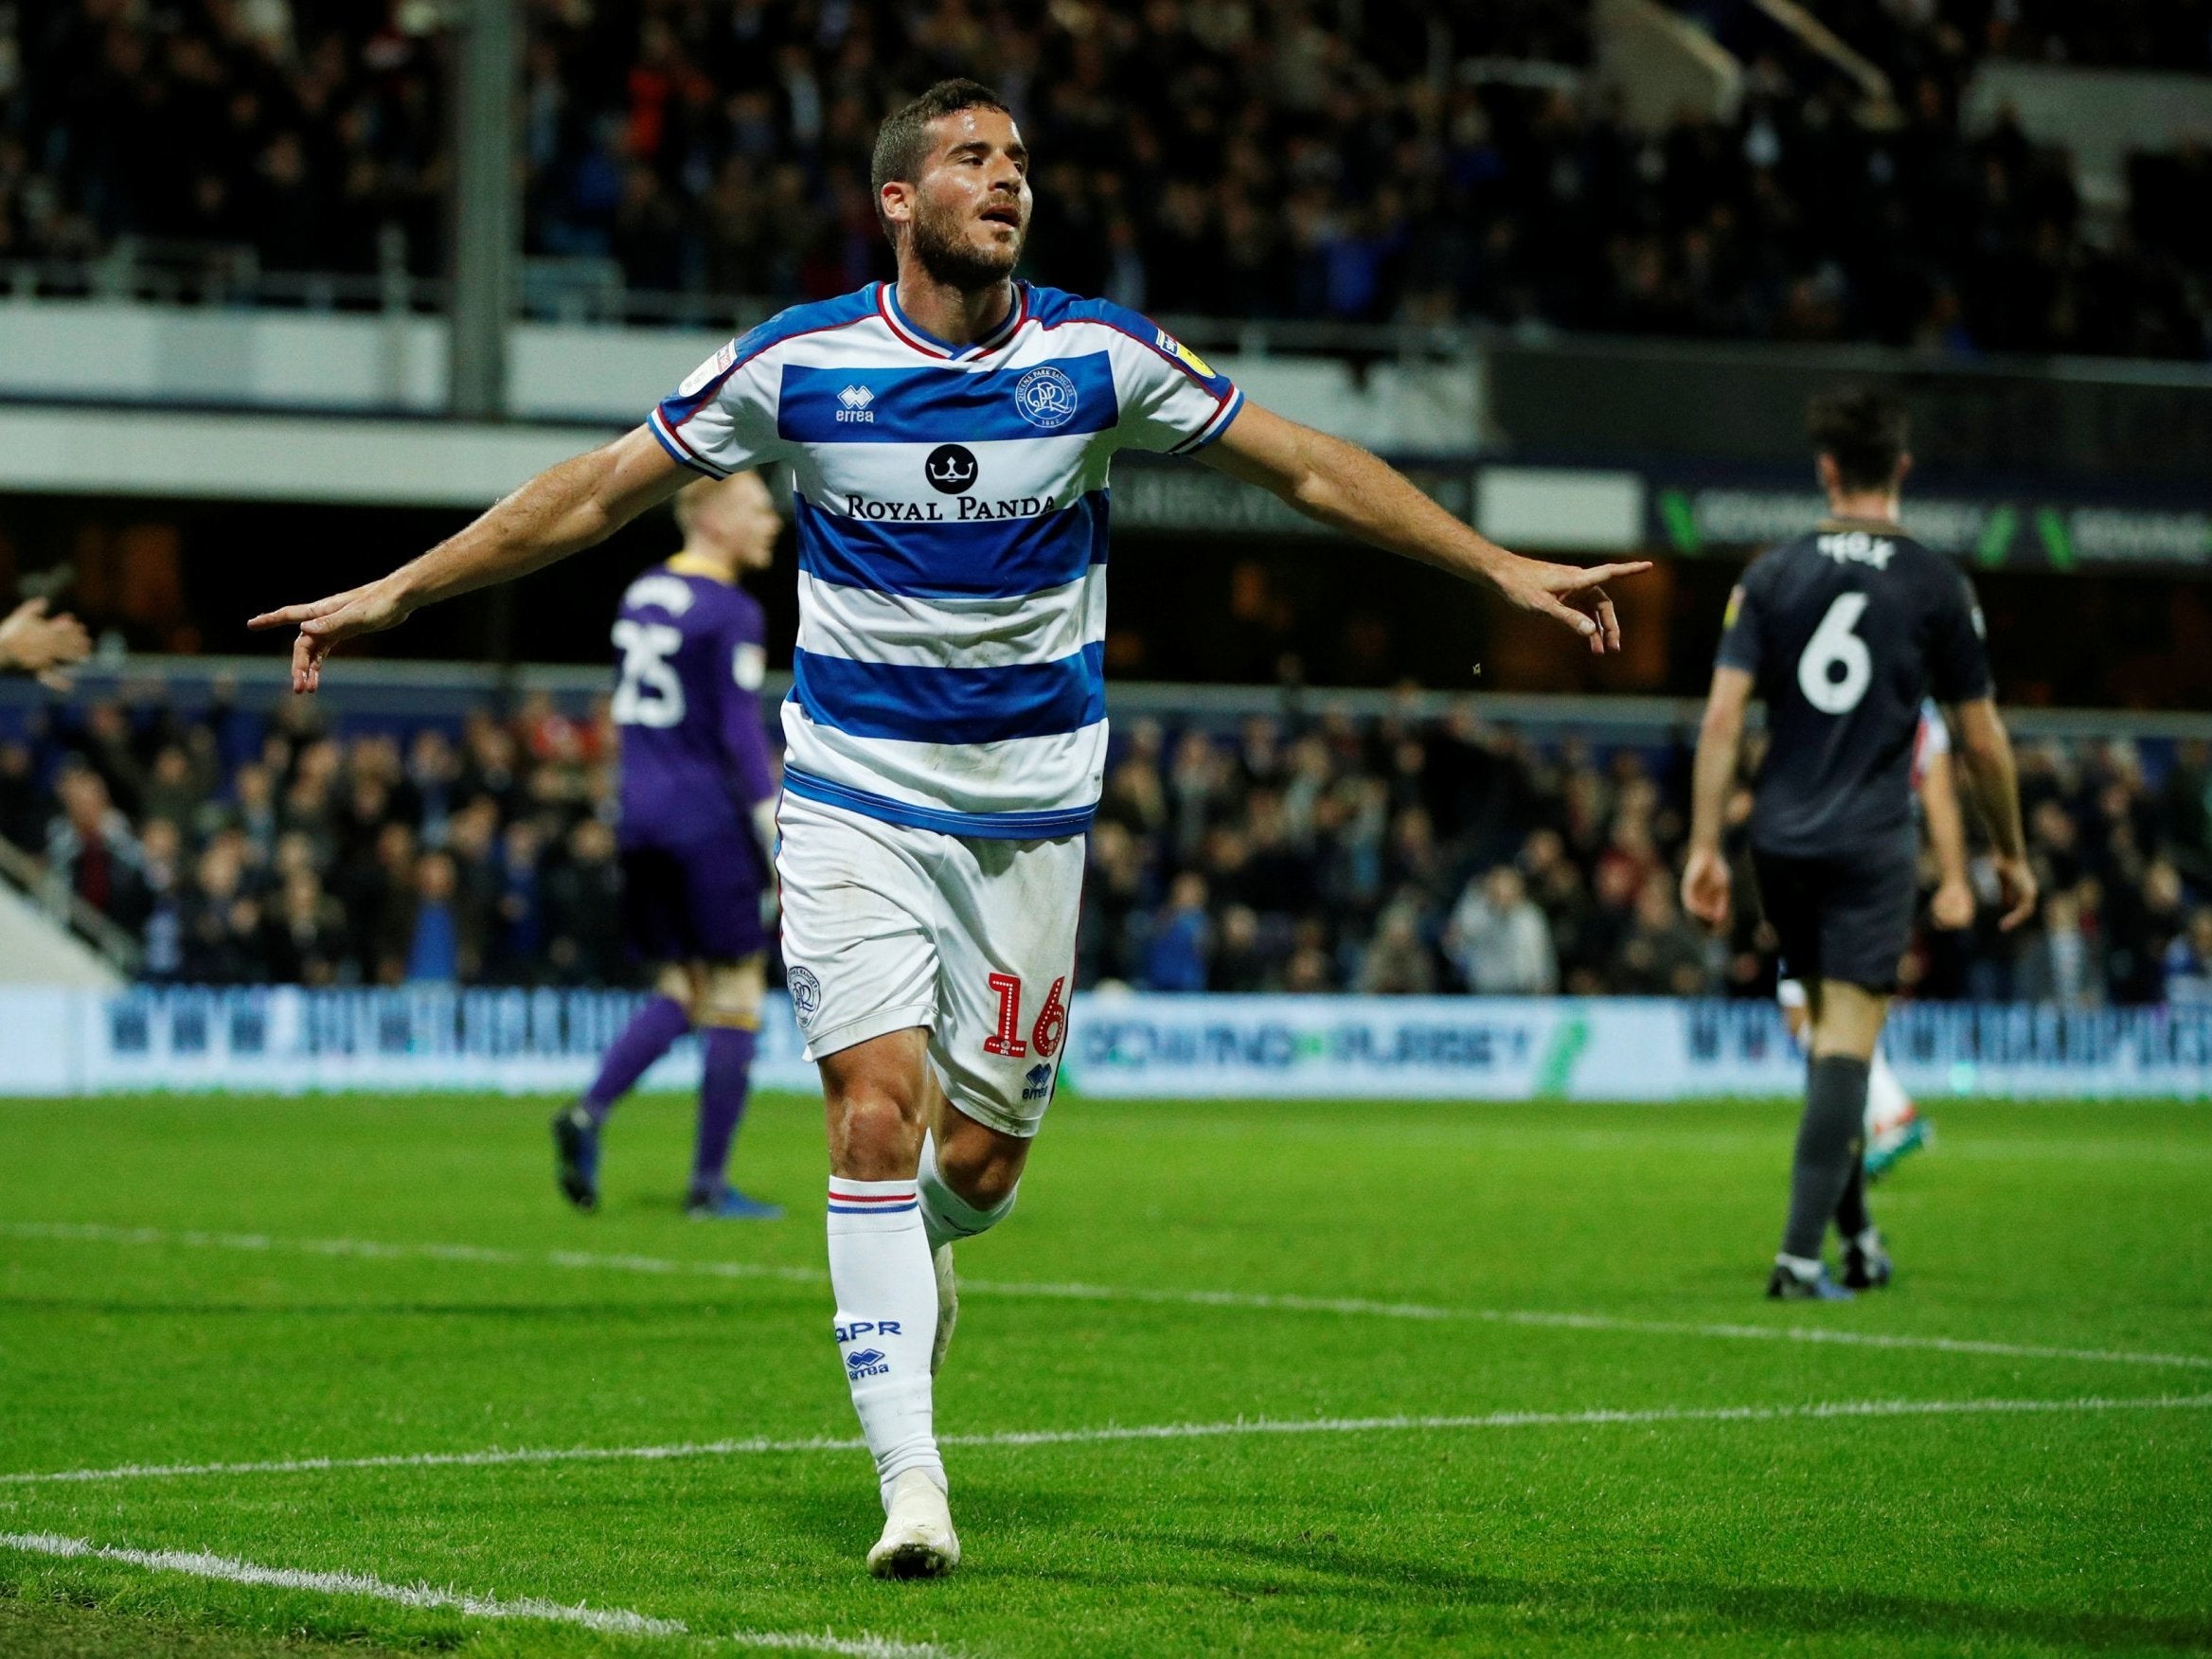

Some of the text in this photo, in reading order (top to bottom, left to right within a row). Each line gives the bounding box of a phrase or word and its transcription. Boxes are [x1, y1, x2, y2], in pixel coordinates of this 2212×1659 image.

[1033, 369, 1050, 378] PARK
[836, 410, 874, 423] errea
[845, 494, 1056, 521] ROYAL PANDA
[611, 618, 687, 729] 25
[1797, 591, 1872, 715] 6
[983, 972, 1065, 1058] 16
